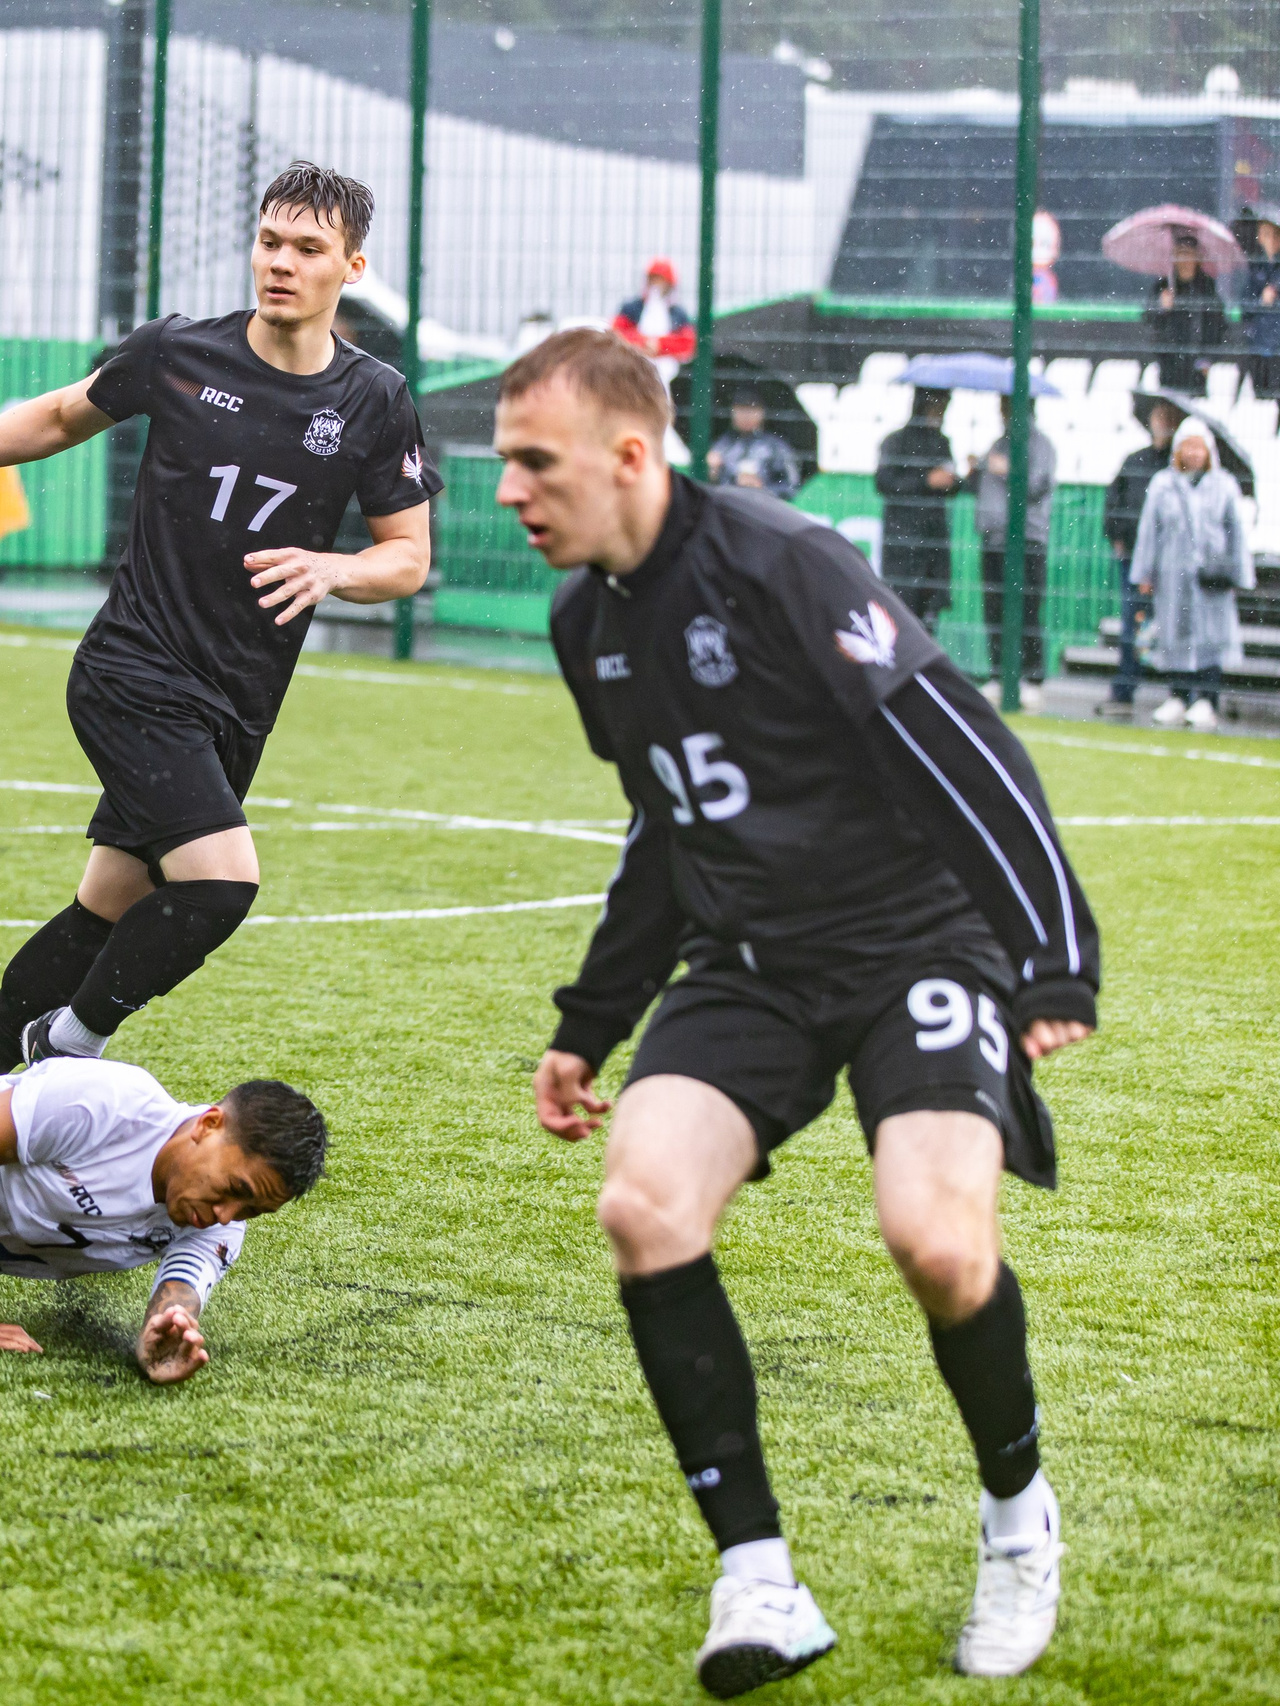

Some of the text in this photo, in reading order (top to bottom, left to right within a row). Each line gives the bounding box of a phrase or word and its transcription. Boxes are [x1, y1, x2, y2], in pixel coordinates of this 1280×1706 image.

[200, 386, 244, 412] RCC
[209, 464, 298, 532] 17
[648, 732, 751, 826] 95
[907, 978, 1009, 1075] 95
[69, 1184, 103, 1217] RCC
